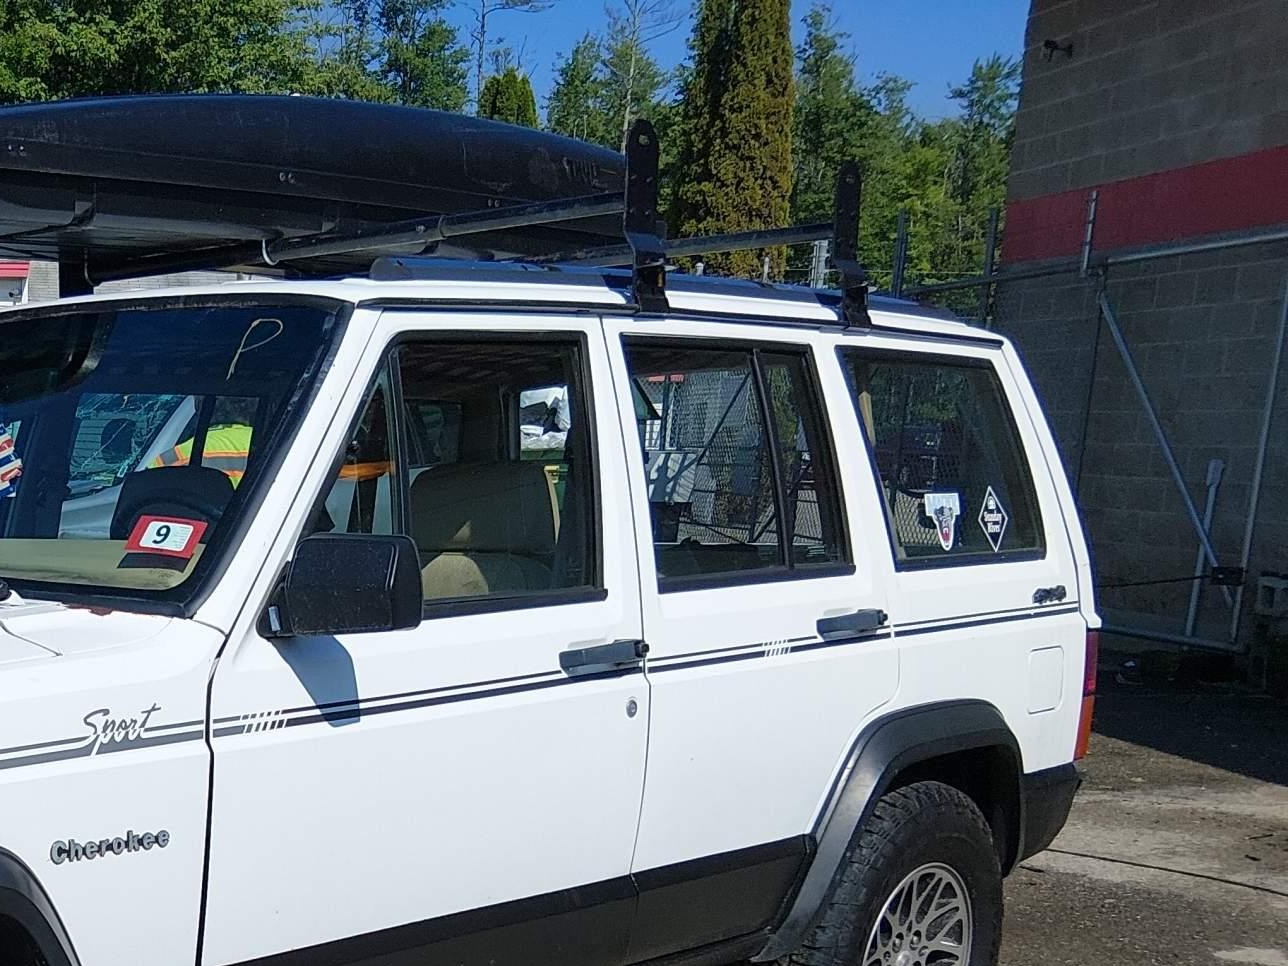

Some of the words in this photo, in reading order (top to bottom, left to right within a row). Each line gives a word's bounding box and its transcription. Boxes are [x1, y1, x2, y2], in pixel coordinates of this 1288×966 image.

[152, 524, 171, 545] 9
[83, 702, 162, 757] Sport
[50, 829, 171, 866] Cherokee
